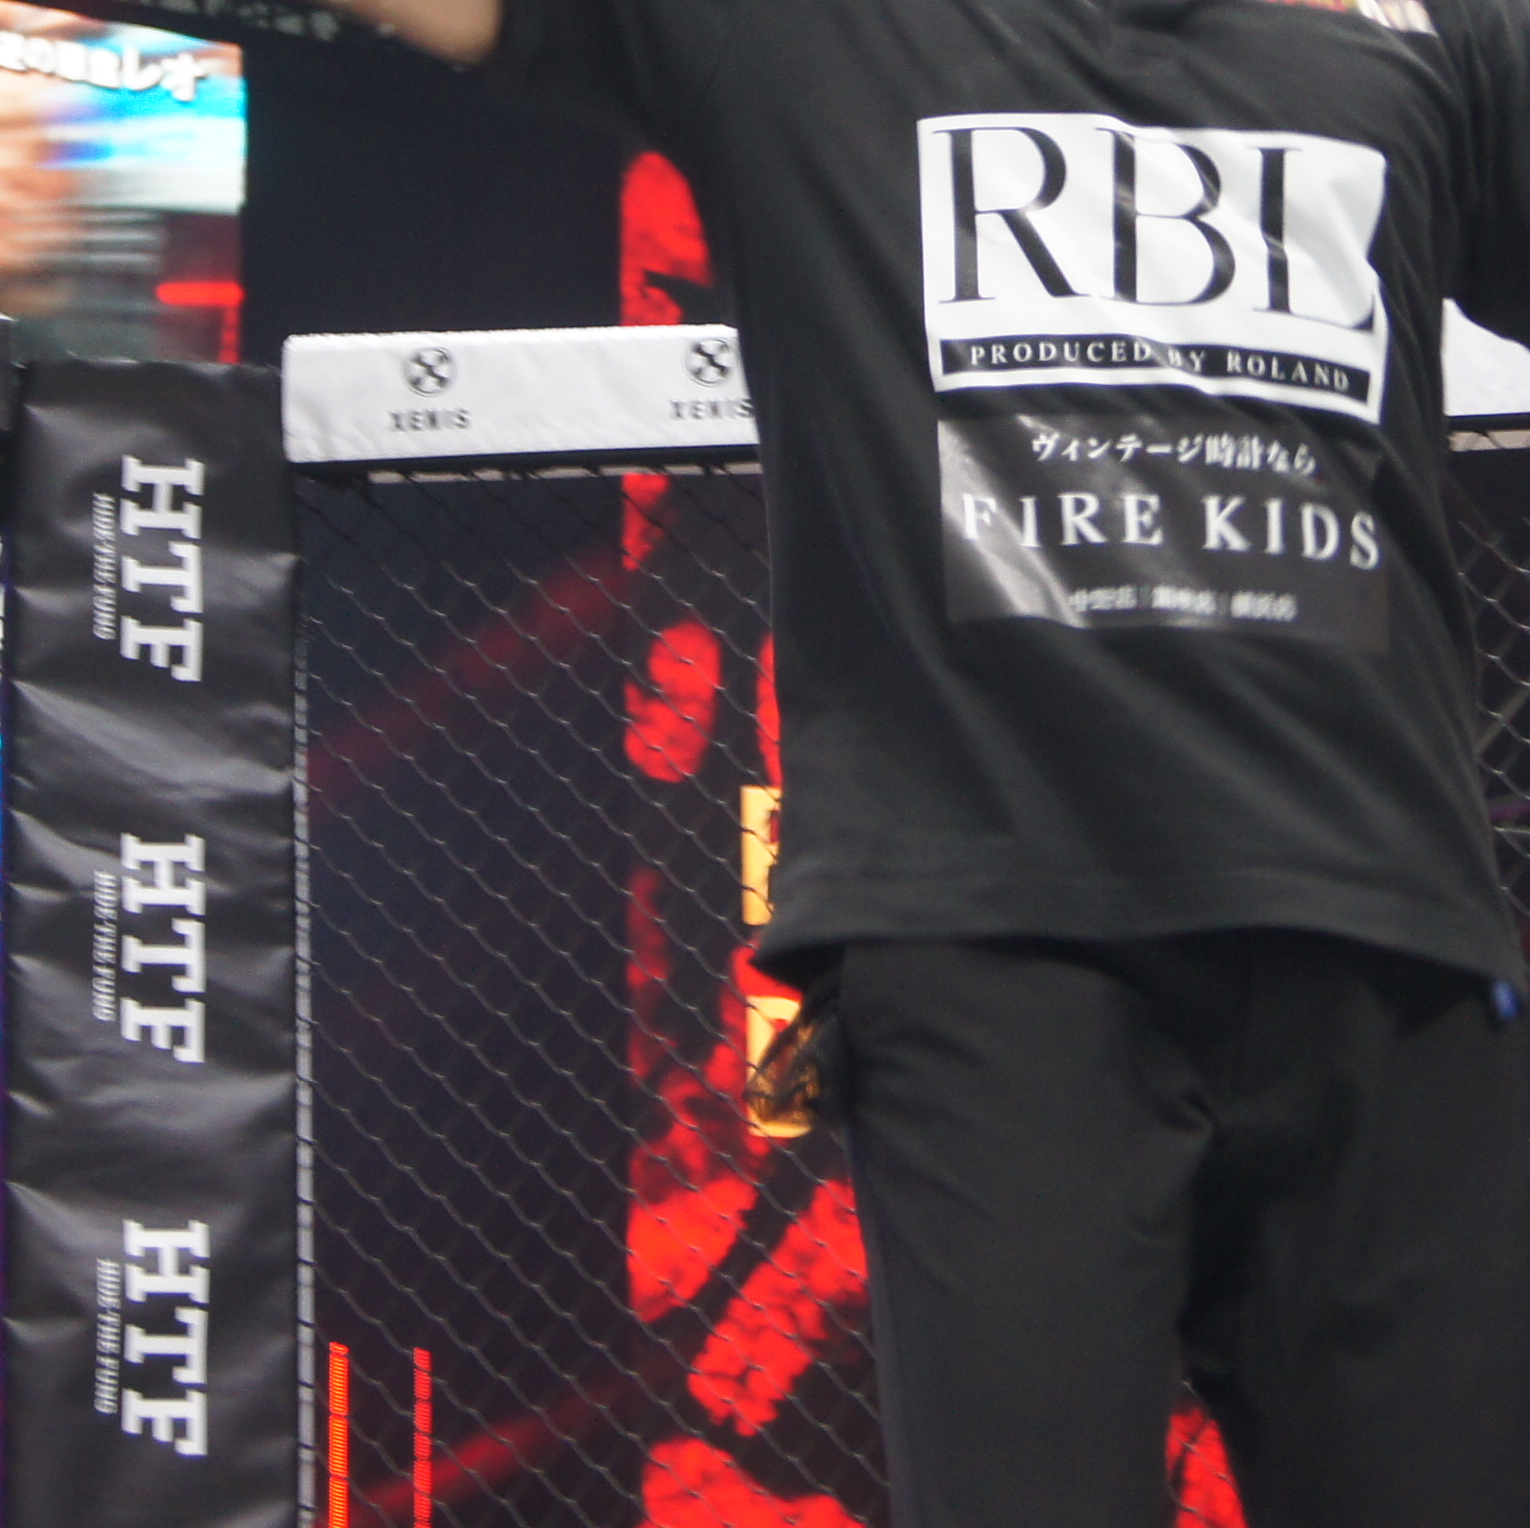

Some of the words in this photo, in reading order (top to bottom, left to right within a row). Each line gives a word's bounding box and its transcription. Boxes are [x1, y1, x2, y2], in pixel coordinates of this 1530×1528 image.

[932, 127, 1376, 335] RBL
[389, 408, 471, 433] XENIS
[671, 398, 754, 422] XENIS
[970, 339, 1153, 366] PRODUCED
[1167, 348, 1206, 374] BY
[1226, 350, 1351, 392] ROLAND
[120, 454, 205, 683] HTF
[962, 491, 1164, 549] FIRE
[1201, 494, 1381, 571] KIDS
[120, 833, 207, 1064] HTF
[122, 1219, 211, 1457] HTF
